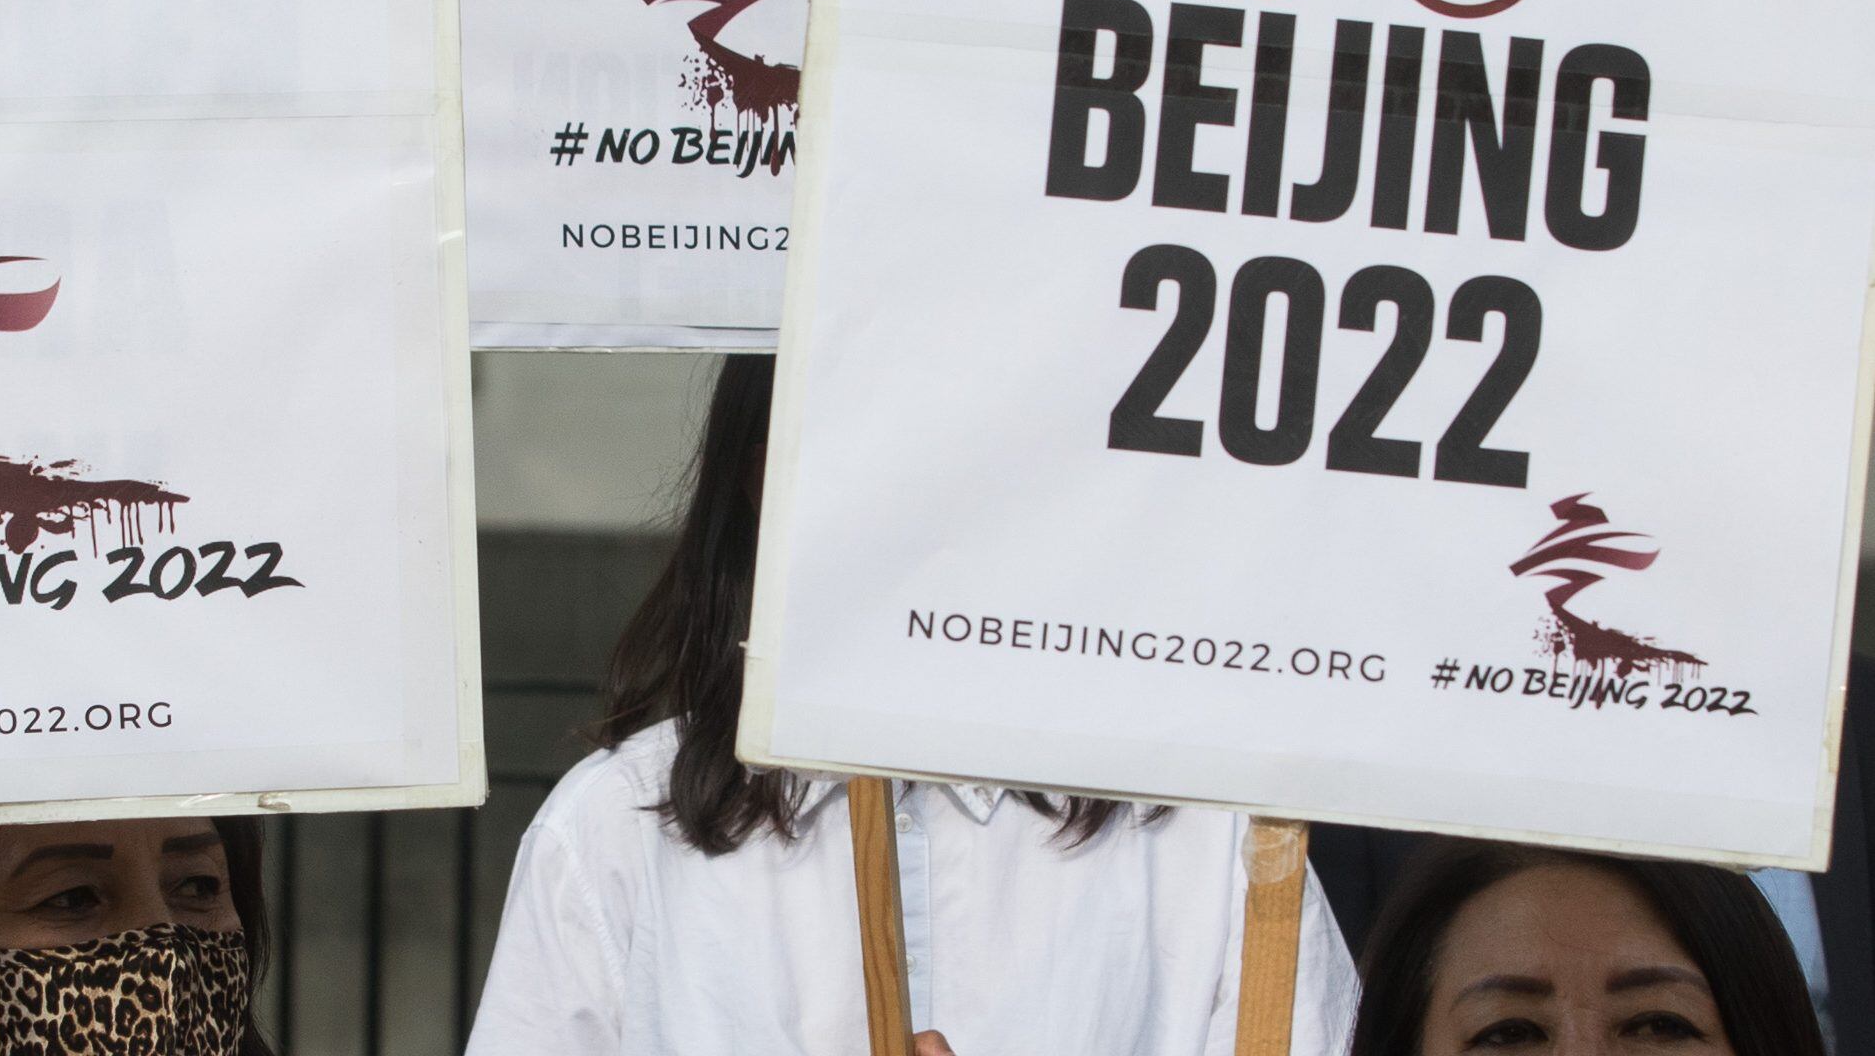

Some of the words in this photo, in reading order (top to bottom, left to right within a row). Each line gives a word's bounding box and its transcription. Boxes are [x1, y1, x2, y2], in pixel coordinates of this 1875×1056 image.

[1107, 244, 1543, 489] 2022
[104, 541, 306, 600] 2022
[908, 609, 1387, 682] NOBEIJING2022.ORG
[1522, 668, 1650, 709] BEIJING
[1660, 683, 1759, 716] 2022
